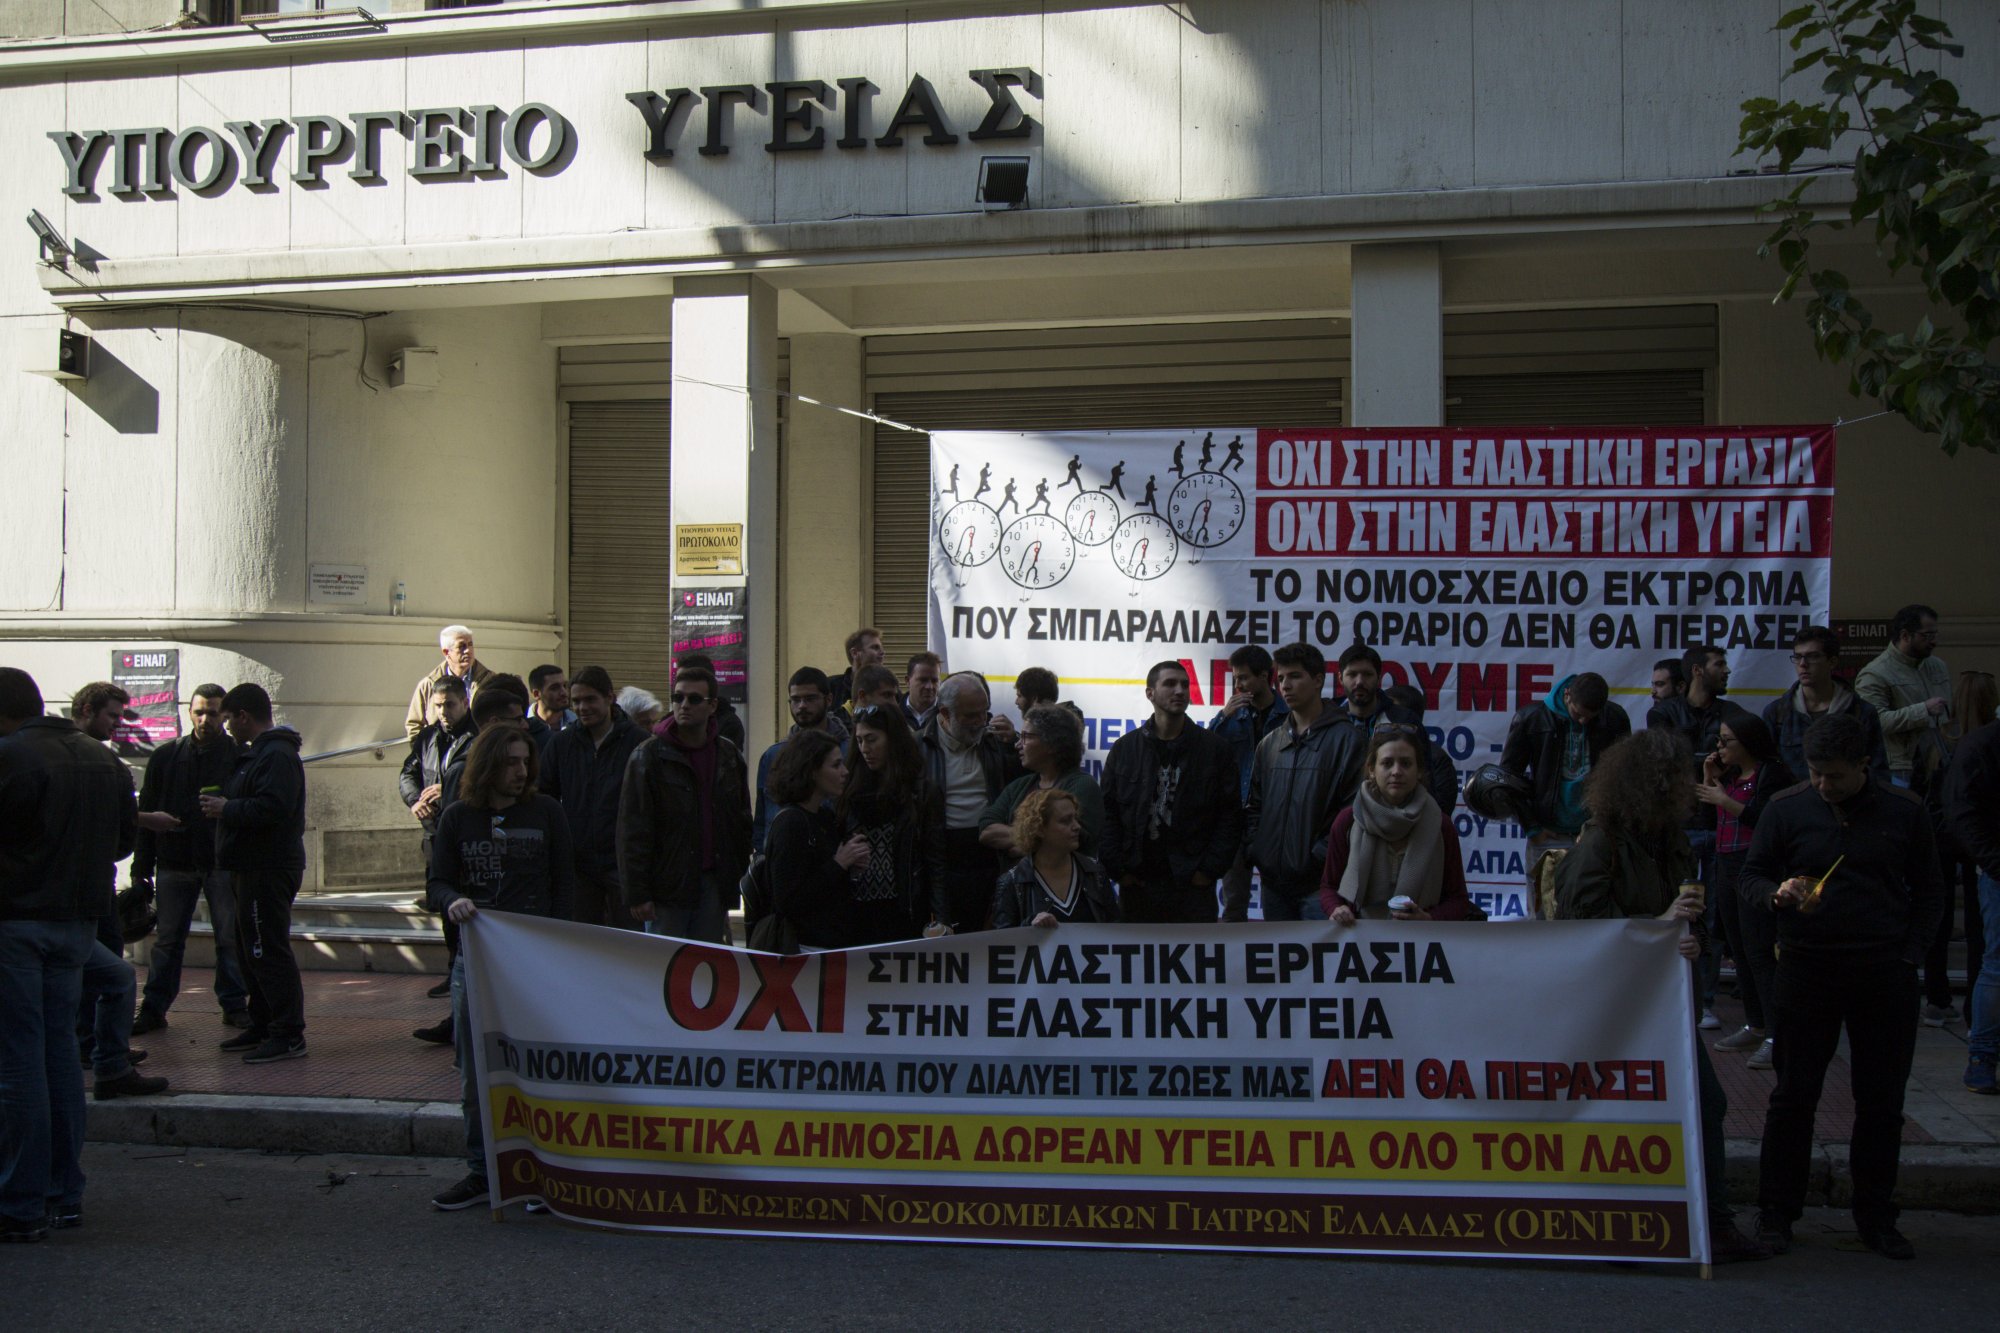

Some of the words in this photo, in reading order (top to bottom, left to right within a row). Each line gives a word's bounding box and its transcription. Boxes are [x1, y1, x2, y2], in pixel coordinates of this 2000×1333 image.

[47, 102, 566, 195] ΥΠΟΥΡΓΕΙΟ
[625, 67, 1031, 159] ΥΓΕΙΑΣ
[1268, 440, 1331, 487] ΟΧΙ
[1343, 440, 1440, 486] ΣΤΗΝ
[1452, 439, 1642, 486] ΕΛΑΣΤΙΚΗ
[1655, 437, 1815, 485] ΕΡΓΑΣΙΑ
[680, 536, 738, 547] ΠΡΩΤΟΚΟΛΛΟ
[1267, 501, 1336, 552] ΟΧΙ
[1346, 501, 1456, 552] ΣΤΗΝ
[1470, 501, 1679, 552] ΕΛΑΣΤΙΚΗ
[1692, 501, 1811, 552] ΥΓΕΙΑ
[696, 592, 733, 606] ΕΙΝΑΠ
[1250, 569, 1301, 603] ΤΟ
[1316, 569, 1588, 606] ΝΟΜΟΣΧΕΔΙΟ
[1604, 571, 1810, 606] ΕΚΤΡΩΜΑ
[952, 606, 1018, 639] ΠΟΥ
[1027, 607, 1279, 645] ΣΜΠΑΡΑΛΙΑΖΕΙ
[1289, 611, 1339, 645] ΤΟ
[1353, 611, 1488, 647] ΩΡΑΡΙΟ
[1501, 613, 1575, 648] ΔΕΝ
[1589, 613, 1641, 649] ΘΑ
[1848, 624, 1887, 638] ΕΙΝΑΠ
[134, 654, 166, 667] ΕΙΝΑΠ
[462, 841, 507, 855] MON
[867, 951, 969, 984] ΣΤΗΝ
[988, 943, 1226, 985] ΕΛΑΣΤΙΚΗ
[1245, 942, 1455, 984] ΕΡΓΑΣΙΑ
[664, 943, 847, 1033] ΟΧΙ
[866, 1003, 968, 1037] ΣΤΗΝ
[988, 997, 1228, 1039] ΕΛΑΣΤΙΚΗ
[1248, 997, 1394, 1039] ΥΓΕΙΑ
[498, 1039, 519, 1073] ΤΟ
[527, 1049, 726, 1088] ΝΟΜΟΣΧΕΔΙΟ
[736, 1057, 885, 1092] ΕΚΤΡΩΜΑ
[898, 1062, 958, 1094] ΠΟΥ
[967, 1063, 1080, 1096] ΔΙΑΛΥΕΙ
[1092, 1064, 1138, 1096] ΤΙΣ
[1148, 1064, 1231, 1097] ΖΩΕΣ
[1243, 1066, 1311, 1098] ΜΑΣ
[1321, 1058, 1404, 1099] ΔΕΝ
[1416, 1059, 1476, 1100] ΘΑ
[1485, 1060, 1667, 1102] ΠΕΡΑΣΕΙ
[503, 1095, 760, 1156] ΑΠΟΚΛΕΙΣΤΙΚΑ
[774, 1121, 961, 1162] ΔΗΜΟΣΙΑ
[974, 1126, 1141, 1165] ΔΩΡΕΑΝ
[1155, 1128, 1274, 1168] ΥΓΕΙΑ
[1290, 1131, 1355, 1169] ΓΙΑ
[1369, 1131, 1458, 1171] ΟΛΟ
[1473, 1133, 1564, 1173] ΤΟΝ
[1580, 1135, 1672, 1175] ΛΑΟ
[696, 1187, 852, 1222] ΕΝΩΣΕΩΝ
[860, 1193, 1157, 1231] ΝΟΣΟΚΟΜΕΙΑΚΩΝ
[1165, 1202, 1312, 1235] ΓΙΑΤΡΩΝ
[1322, 1204, 1485, 1240] ΕΛΛΑΔΑΣ
[1494, 1207, 1671, 1248] (ΟΕΝΓΕ)
